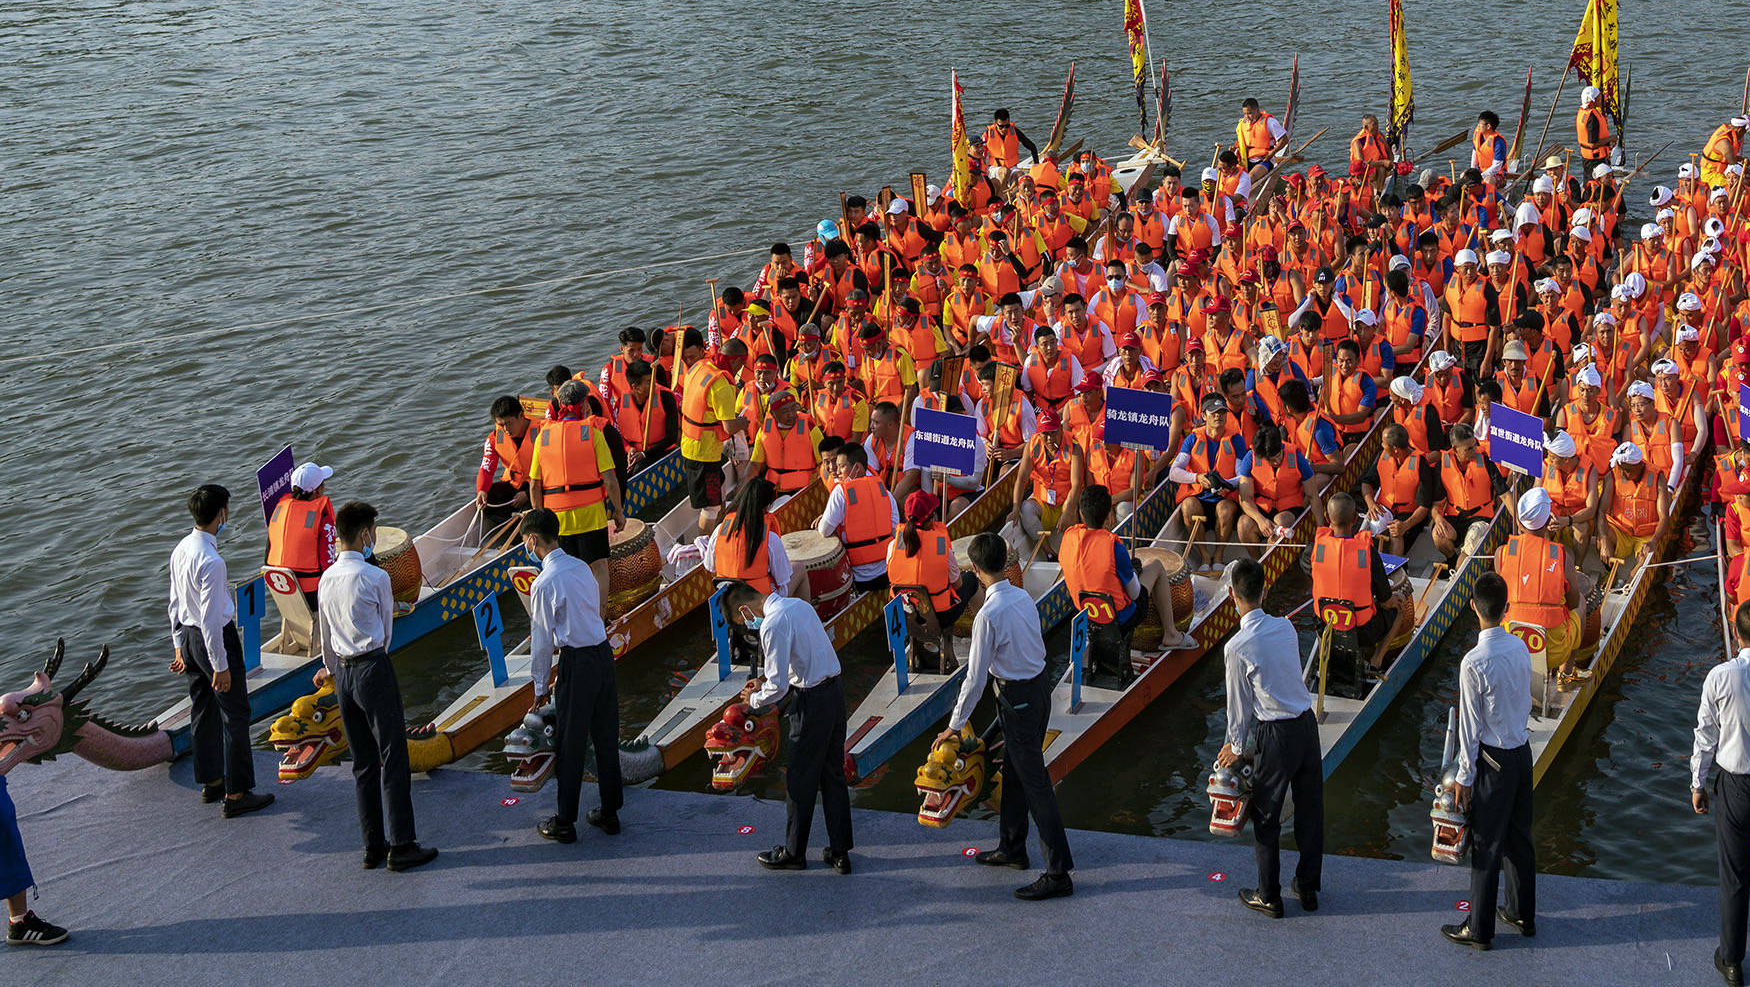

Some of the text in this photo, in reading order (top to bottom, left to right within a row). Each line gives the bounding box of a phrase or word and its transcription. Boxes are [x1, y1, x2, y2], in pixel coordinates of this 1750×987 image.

[1106, 408, 1169, 427] 骑龙镇龙舟队
[914, 429, 976, 450] 东湖街道龙舟队
[1490, 425, 1542, 451] 富世街道龙舟队
[269, 572, 290, 592] 8
[244, 582, 255, 616] 1
[480, 601, 498, 639] 2
[1084, 602, 1113, 619] 01
[1323, 608, 1352, 626] 07
[891, 604, 902, 638] 4
[1075, 616, 1084, 653] 5
[504, 797, 517, 805] 10
[966, 848, 977, 856] 6
[1212, 873, 1221, 881] 4
[1458, 901, 1469, 911] 2
